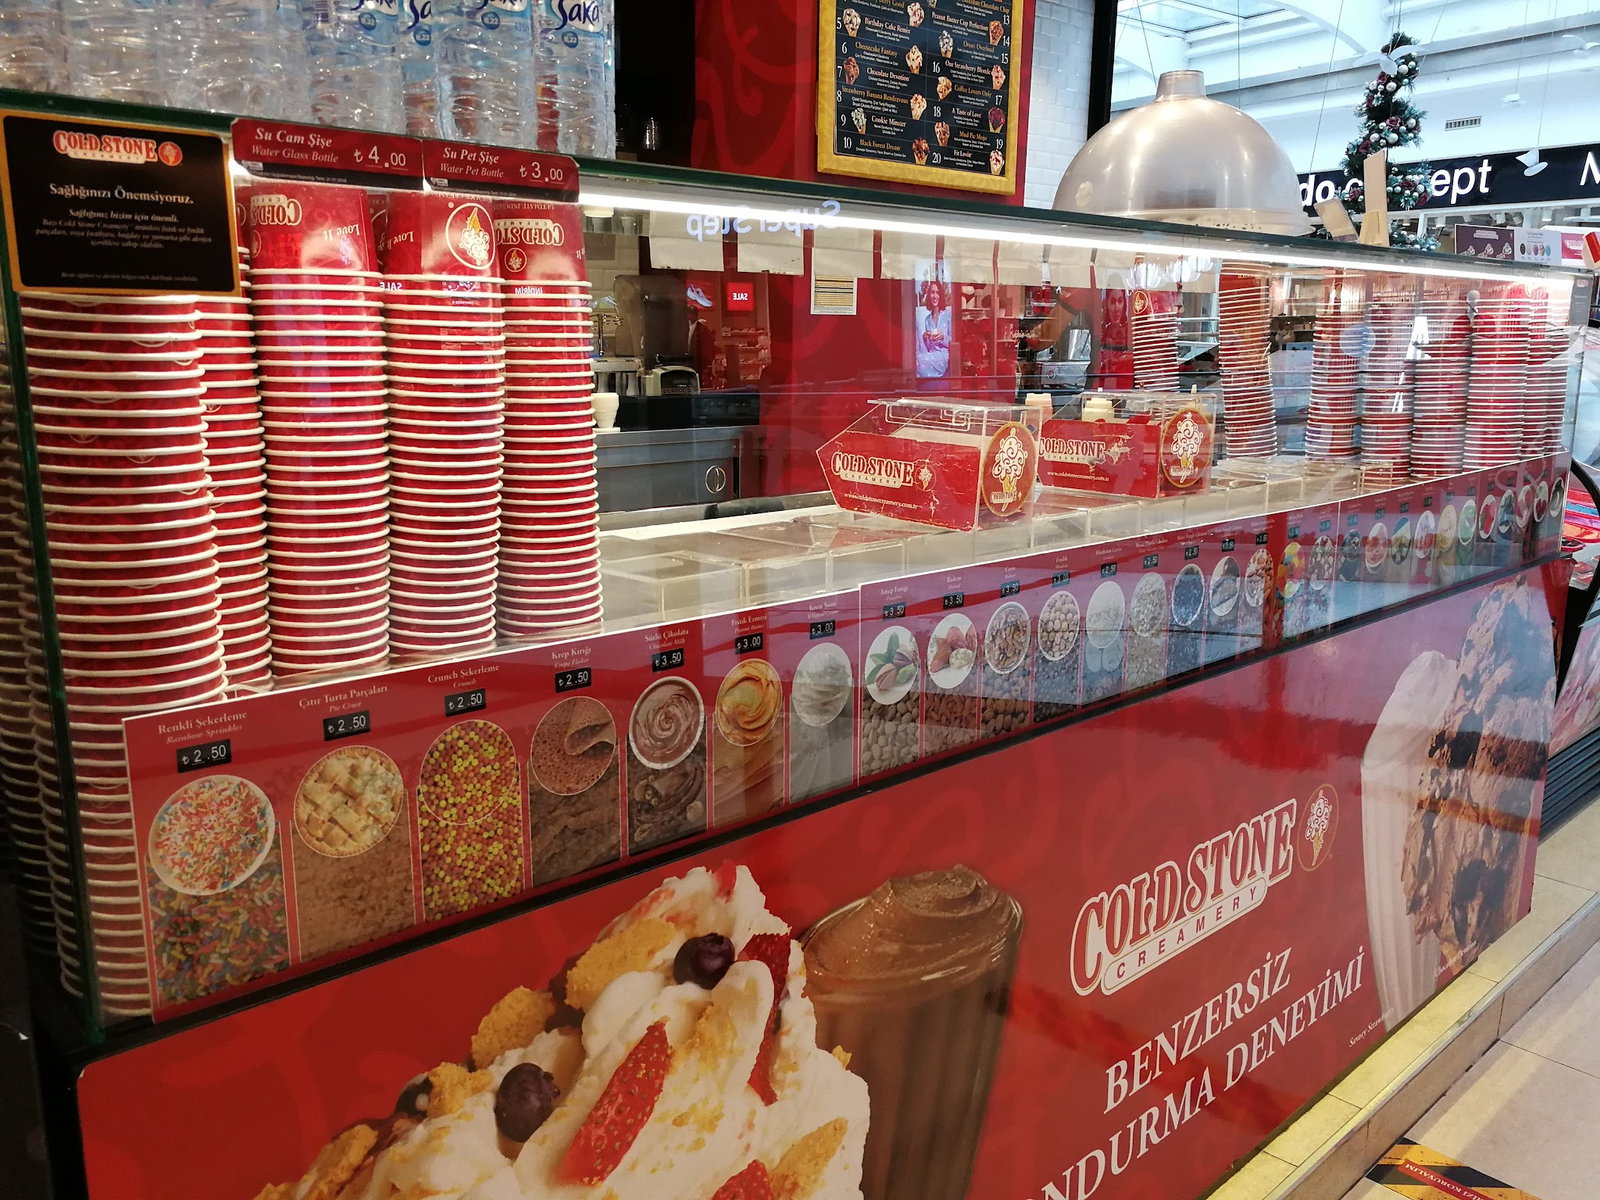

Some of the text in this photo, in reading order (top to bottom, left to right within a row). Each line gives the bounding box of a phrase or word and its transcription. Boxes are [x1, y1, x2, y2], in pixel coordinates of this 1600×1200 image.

[836, 17, 842, 30] 5
[1003, 15, 1010, 25] 13
[841, 42, 848, 54] 6
[1002, 35, 1010, 47] 14
[1001, 53, 1009, 64] 15
[837, 66, 843, 78] 7
[932, 61, 940, 73] 16
[836, 90, 842, 102] 8
[995, 94, 1003, 106] 17
[840, 114, 847, 126] 9
[933, 106, 941, 118] 18
[53, 130, 158, 162] COLD STONE
[255, 127, 272, 141] Su
[276, 130, 305, 145] Cam
[307, 133, 333, 149] Şişe
[843, 137, 852, 149] 10
[996, 138, 1004, 150] 19
[252, 144, 339, 163] Water Glass Bottle
[443, 147, 457, 159] Su
[460, 148, 476, 162] Pet
[478, 150, 499, 166] Şişe
[932, 152, 942, 164] 20
[440, 162, 504, 178] Water Pet Bottle
[49, 183, 194, 205] Sağlığınızı Önemsiyoruz.
[323, 224, 360, 242] Love It
[495, 227, 521, 245] STO
[831, 452, 914, 487] COLD STONE
[427, 670, 458, 683] Crunch
[325, 694, 348, 704] Turta
[349, 685, 388, 698] Parçaları
[158, 712, 248, 735] Renkli Şekerleme
[1069, 799, 1297, 997] COLD STONE
[1115, 884, 1259, 980] CREAMERY
[1103, 947, 1292, 1114] BENZERSİZ
[1030, 945, 1365, 1200] NDURMA DENEYİMİ
[1405, 1163, 1462, 1193] KORUYALIM
